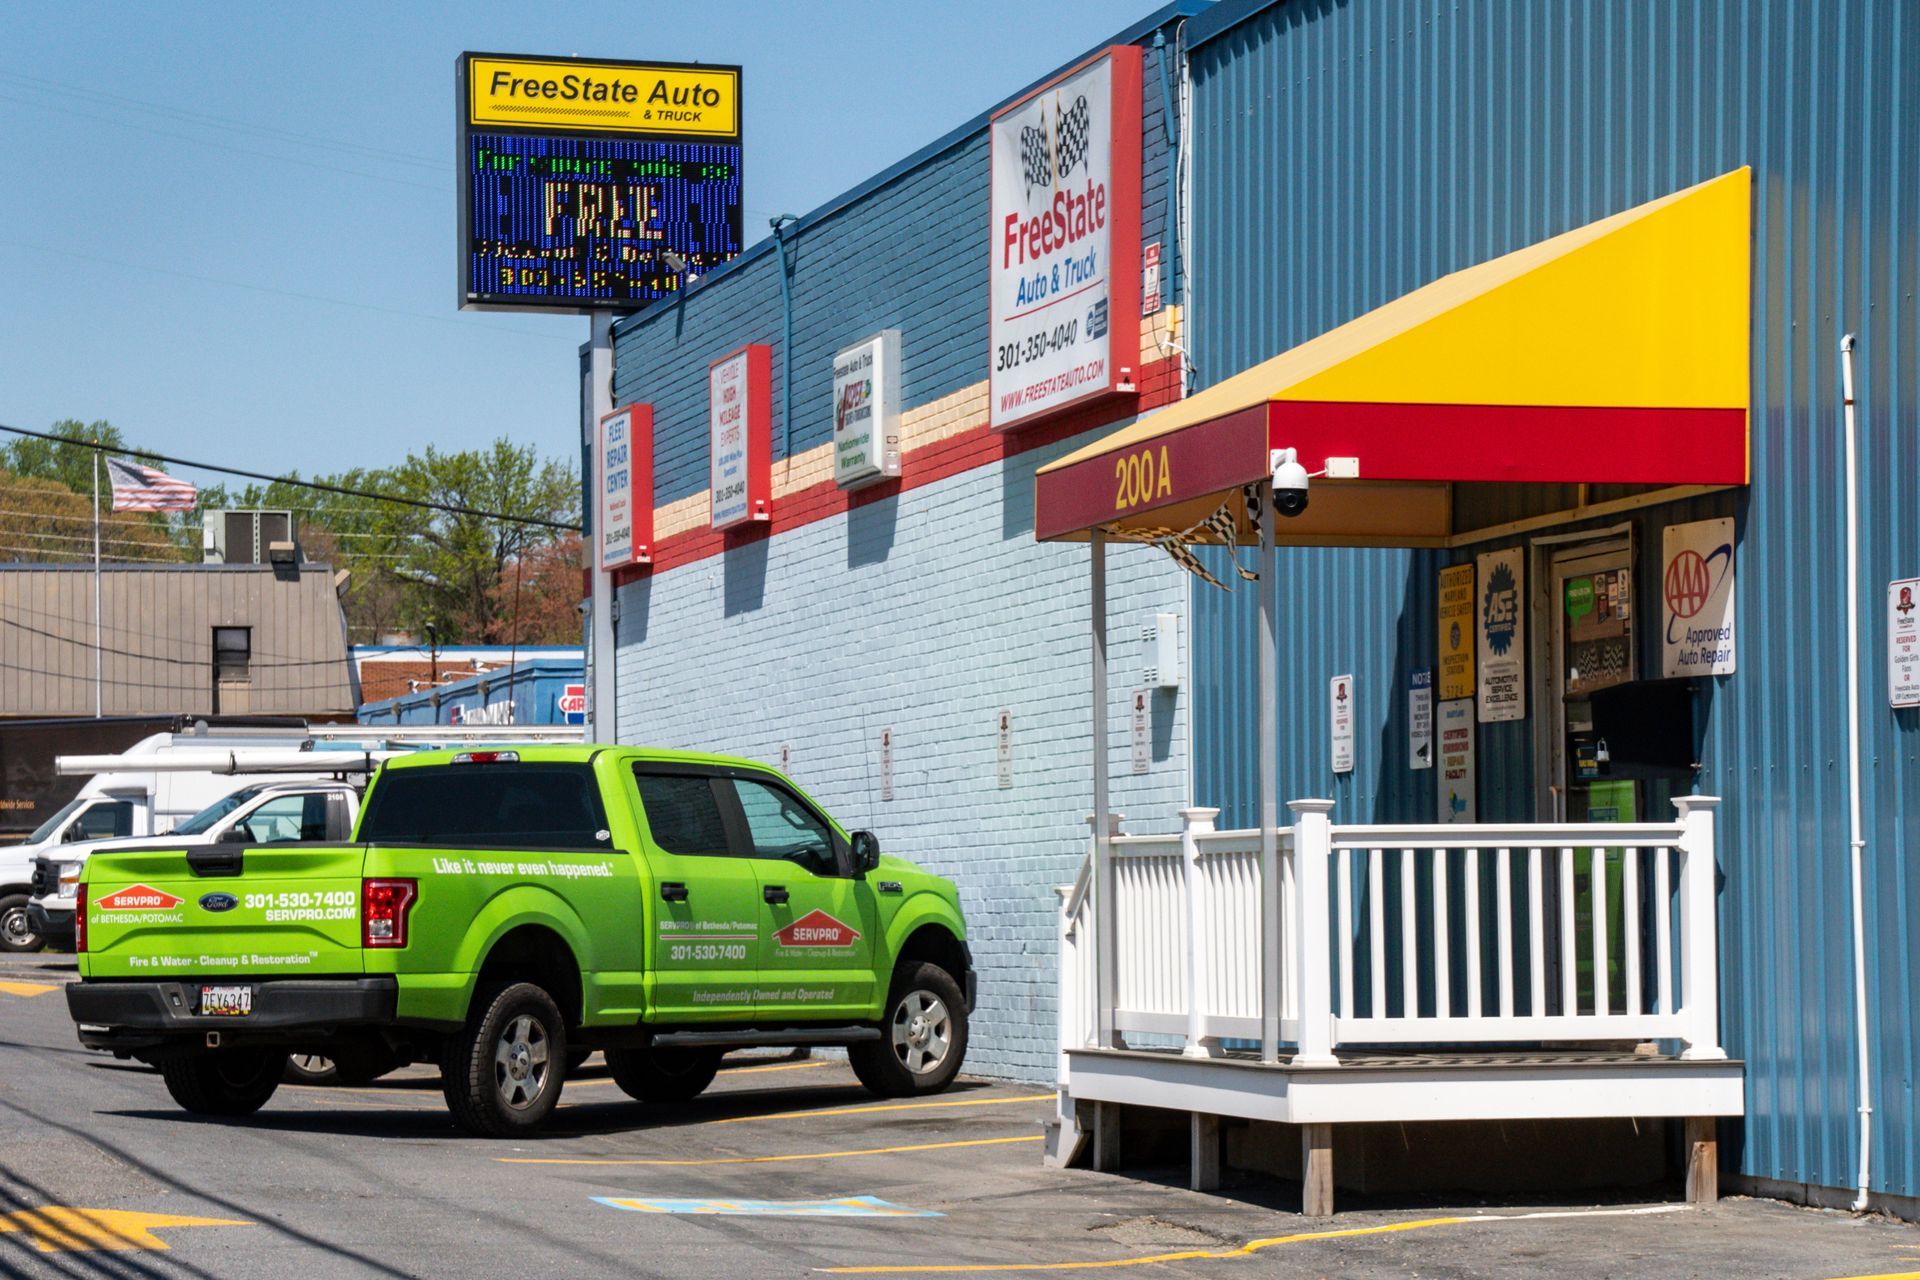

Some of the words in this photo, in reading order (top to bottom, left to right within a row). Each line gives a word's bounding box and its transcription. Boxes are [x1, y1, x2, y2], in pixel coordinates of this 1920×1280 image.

[490, 70, 639, 103] FreeState
[647, 79, 721, 108] Auto
[643, 109, 652, 120] &
[657, 110, 702, 122] TRUCK
[1004, 178, 1105, 270] FreeState
[1016, 271, 1047, 307] Auto
[1051, 263, 1060, 294] &
[1065, 245, 1096, 288] Truck
[997, 318, 1078, 372] 301-350-4040
[1000, 358, 1105, 412] WWW.FREESTATEAUTO.COM
[719, 404, 741, 427] MILEAGE
[608, 419, 625, 444] FLEET
[606, 444, 628, 469] REPAIR
[607, 469, 628, 494] CENTER
[1668, 553, 1707, 616] AAA
[1685, 622, 1731, 647] Approved
[1677, 648, 1699, 666] Auto
[1700, 646, 1731, 667] Repair
[433, 857, 462, 874] Like
[462, 858, 476, 874] it
[478, 861, 514, 875] never
[517, 863, 548, 876] even
[244, 890, 355, 908] 301-530-7400
[91, 914, 99, 924] of
[101, 913, 184, 924] BETHESDA/POTOMAC
[265, 907, 356, 921] SERVPRO.COM
[129, 956, 149, 967] Fire
[151, 956, 159, 967] &
[160, 956, 192, 967] Water
[199, 955, 239, 967] Cleanup
[241, 954, 249, 965] &
[671, 944, 746, 960] 301-530-7400
[693, 989, 752, 1004] Independently
[752, 988, 780, 1000] Owned
[781, 988, 797, 1000] and
[797, 988, 834, 1002] Operated
